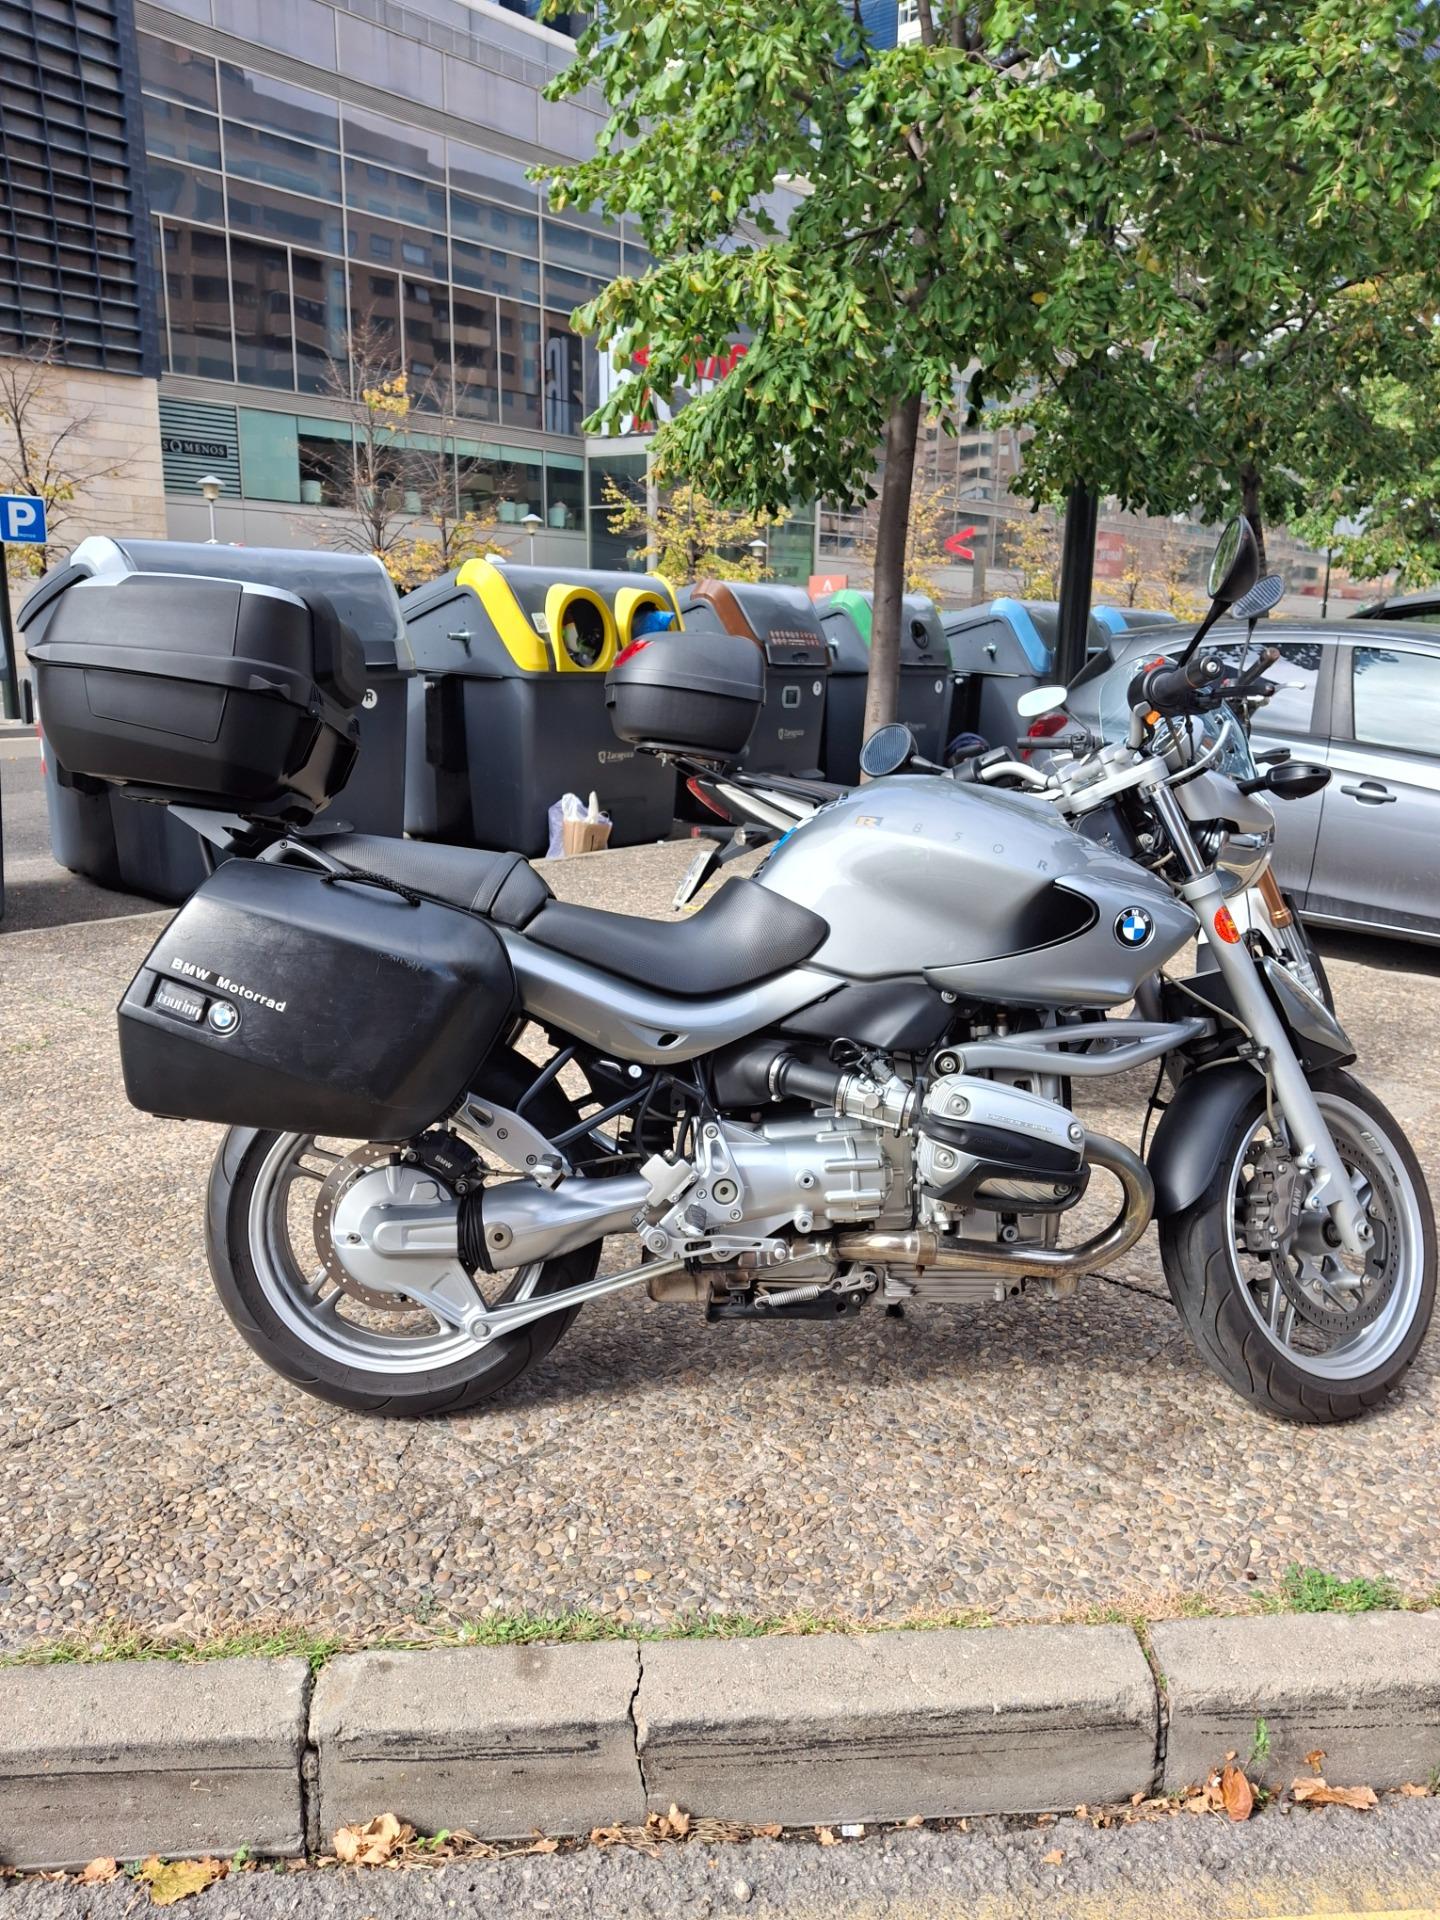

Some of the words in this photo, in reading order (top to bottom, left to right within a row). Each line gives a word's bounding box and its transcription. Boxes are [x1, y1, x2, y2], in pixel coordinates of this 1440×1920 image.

[8, 501, 36, 537] P
[170, 957, 210, 981] BMW
[215, 976, 287, 1013] Motorrad
[434, 1154, 453, 1169] BMW
[1291, 1186, 1301, 1216] BMW
